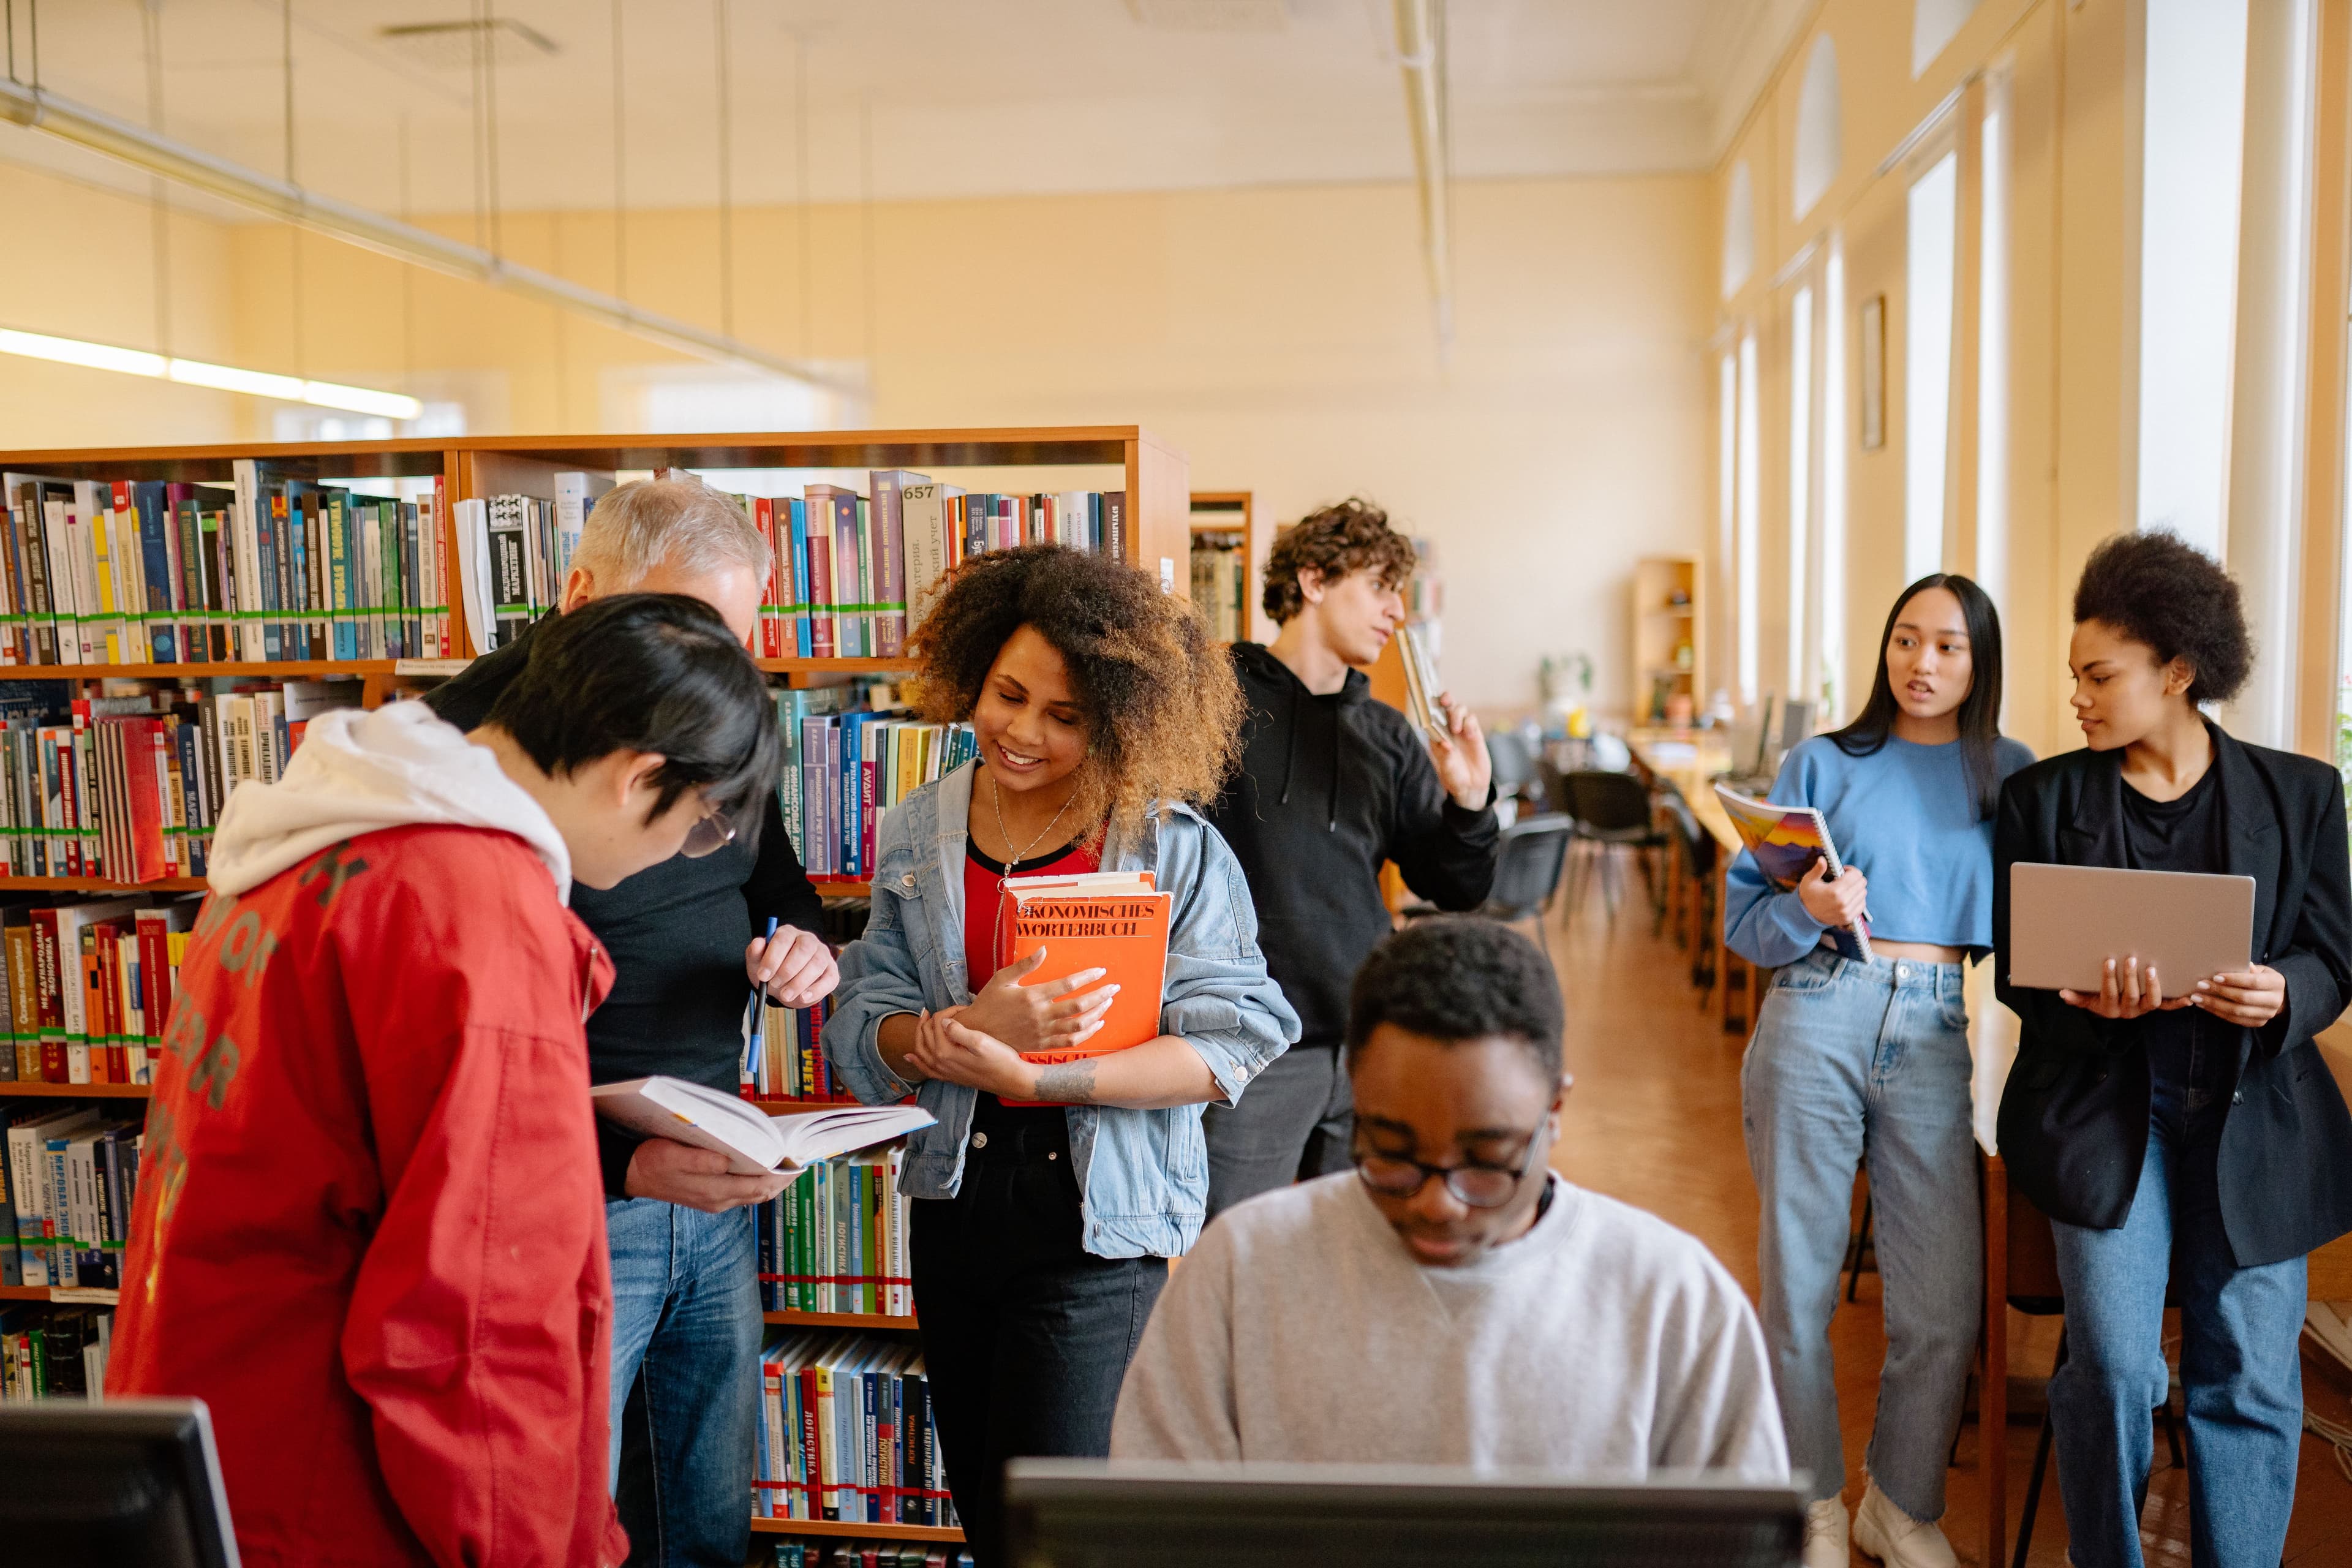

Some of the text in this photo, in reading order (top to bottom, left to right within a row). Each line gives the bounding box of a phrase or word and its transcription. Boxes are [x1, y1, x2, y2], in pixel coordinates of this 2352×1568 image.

[903, 486, 934, 499] 657
[330, 500, 346, 609] МИРОВАЯ ЭКОНОМИКА
[780, 525, 790, 567] ЭКОНОМИКА
[930, 516, 941, 543] учет
[279, 565, 288, 611] ЭКОНОМИК
[437, 543, 448, 638] ВНЕШЭКОНОМИЧЕСКАЯ
[498, 534, 511, 603] МЕЖДУНАРОДНЫЙ
[509, 541, 520, 596] МАРКЕТИНГ
[782, 568, 791, 606] ЗАРУБЕЖН
[790, 765, 801, 834] ФИНАНСОВЫЙ
[815, 767, 824, 816] ФИНАНСОВЫЙ
[862, 767, 872, 805] АУДИТ
[816, 843, 824, 871] АНАЛИЗ
[36, 923, 48, 1009] МЕЖДУНАРОДНАЯ
[45, 936, 56, 997] ЭКОНОМИКА
[802, 1049, 814, 1095] УЧЕТ
[810, 1003, 828, 1095] УХГАЛТЕРСКИЙ
[55, 1155, 74, 1278] МИРОВАЯ ЭКОМИКА
[837, 1221, 846, 1275] ЛОГИСТИКА
[804, 1411, 816, 1475] ЛОГИСТИКА
[923, 1428, 933, 1512] МЕЖДУНАРОДНАЯ ЛОГТИКА
